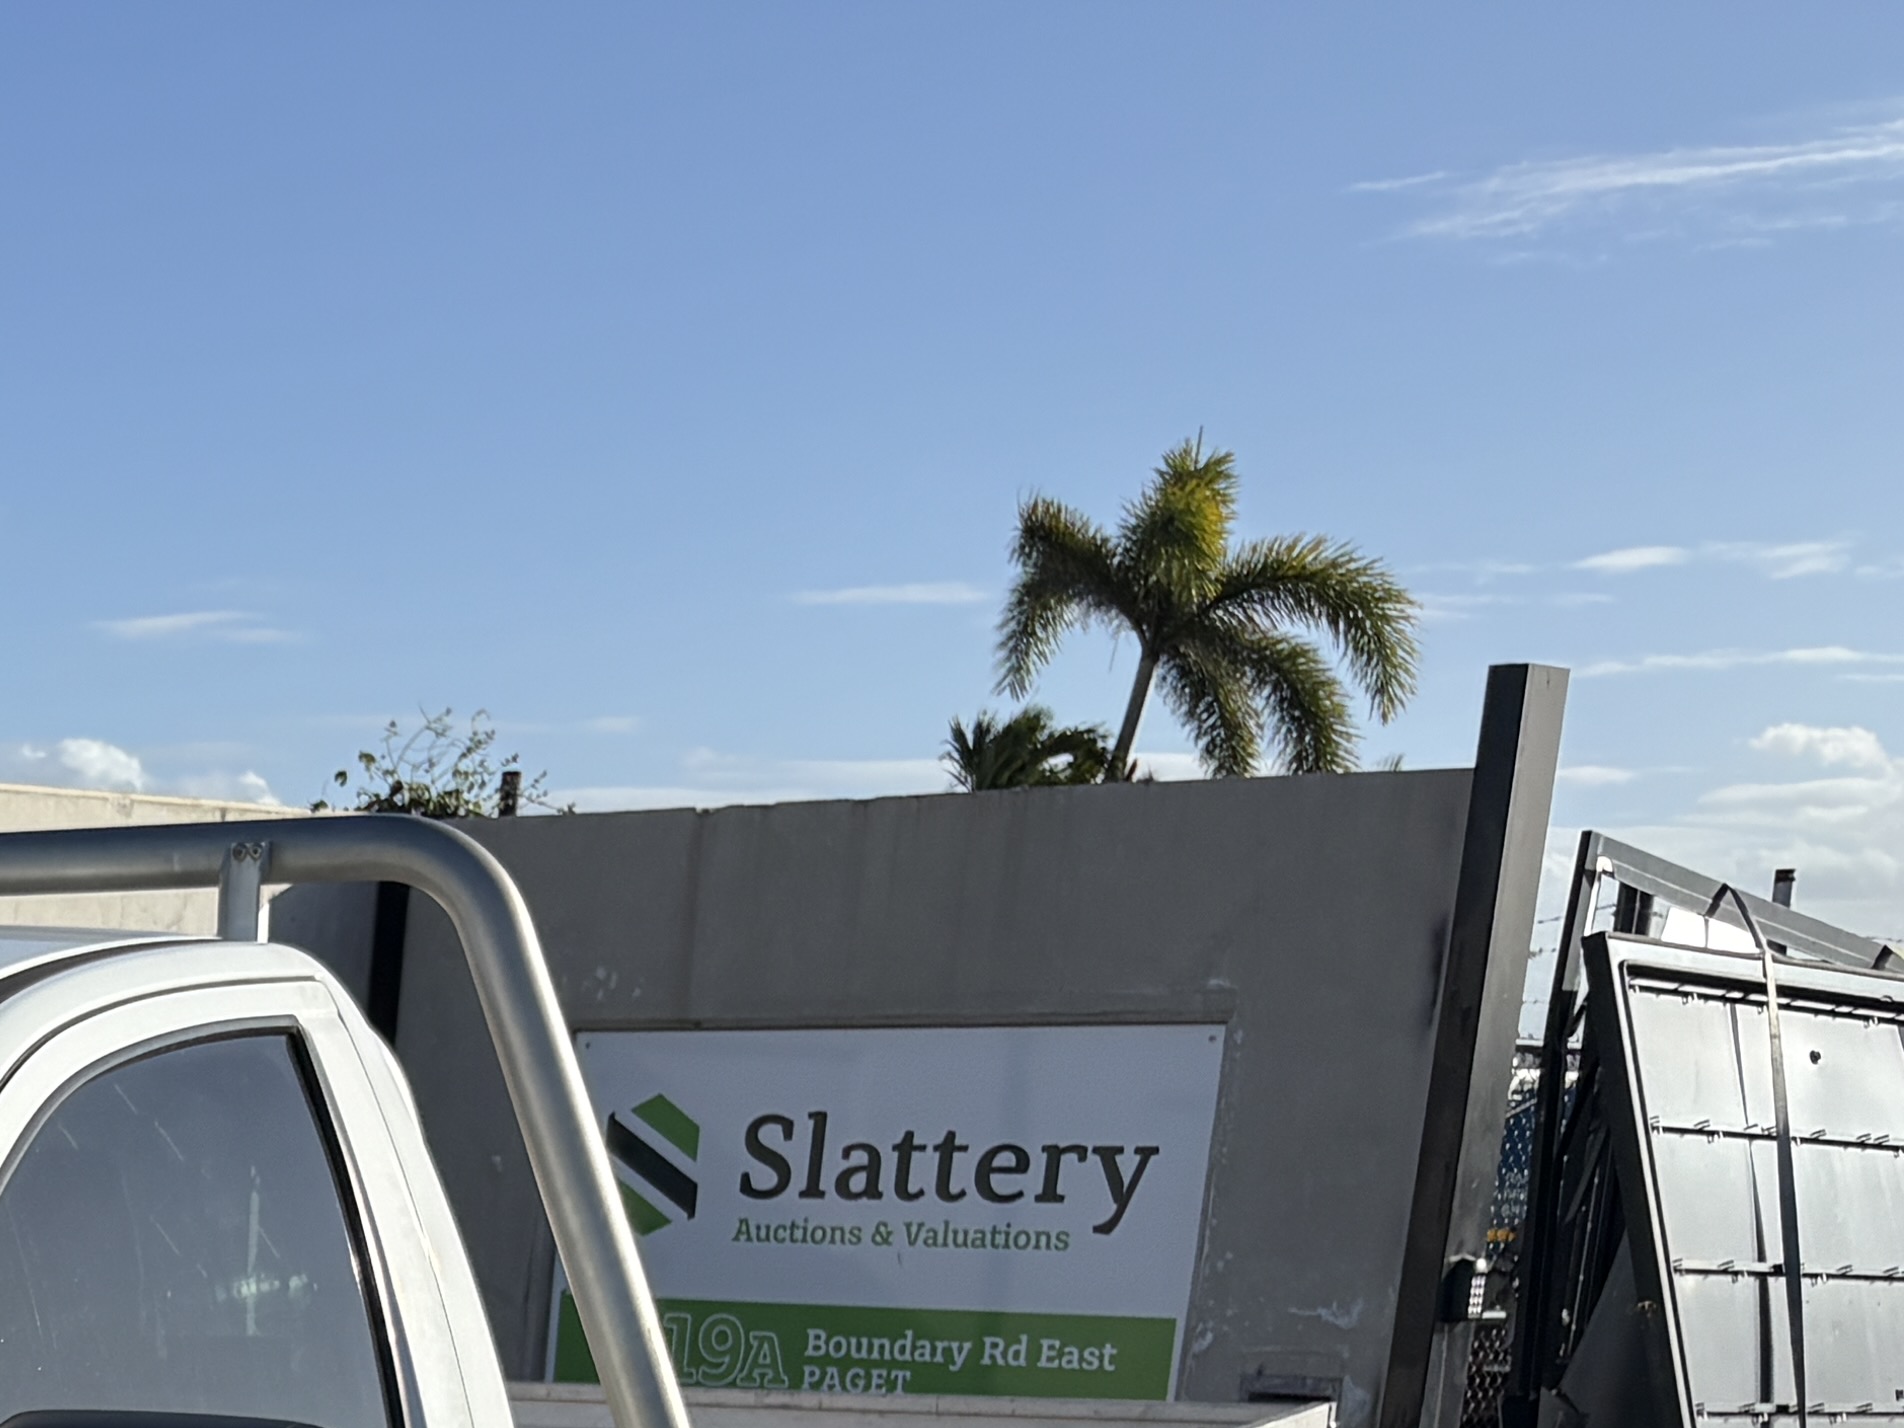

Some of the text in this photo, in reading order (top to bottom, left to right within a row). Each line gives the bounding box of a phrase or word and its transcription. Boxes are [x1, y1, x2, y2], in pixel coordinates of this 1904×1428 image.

[738, 1110, 1161, 1236] Slattery
[731, 1217, 1072, 1253] Auctions & Valuations
[664, 1312, 790, 1389] 19A
[804, 1327, 1119, 1373] Boundary Rd East
[801, 1365, 912, 1395] PAGET
